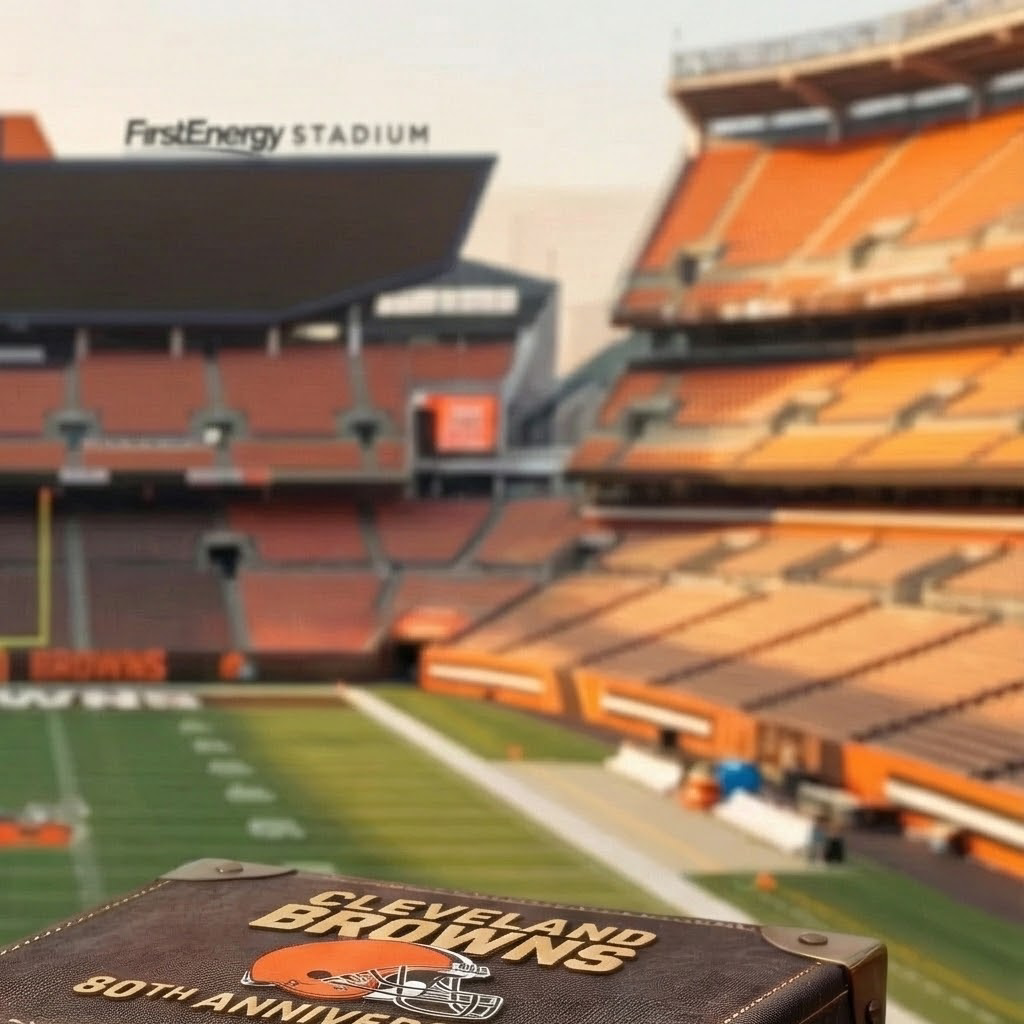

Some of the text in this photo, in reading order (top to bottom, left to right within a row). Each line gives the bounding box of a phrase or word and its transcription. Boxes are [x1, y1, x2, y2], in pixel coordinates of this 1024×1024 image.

[125, 118, 430, 151] FirstEnergy STADIUM
[249, 903, 638, 976] BROWNS
[307, 890, 657, 950] CLEVELAND
[73, 975, 200, 1002] 80TH
